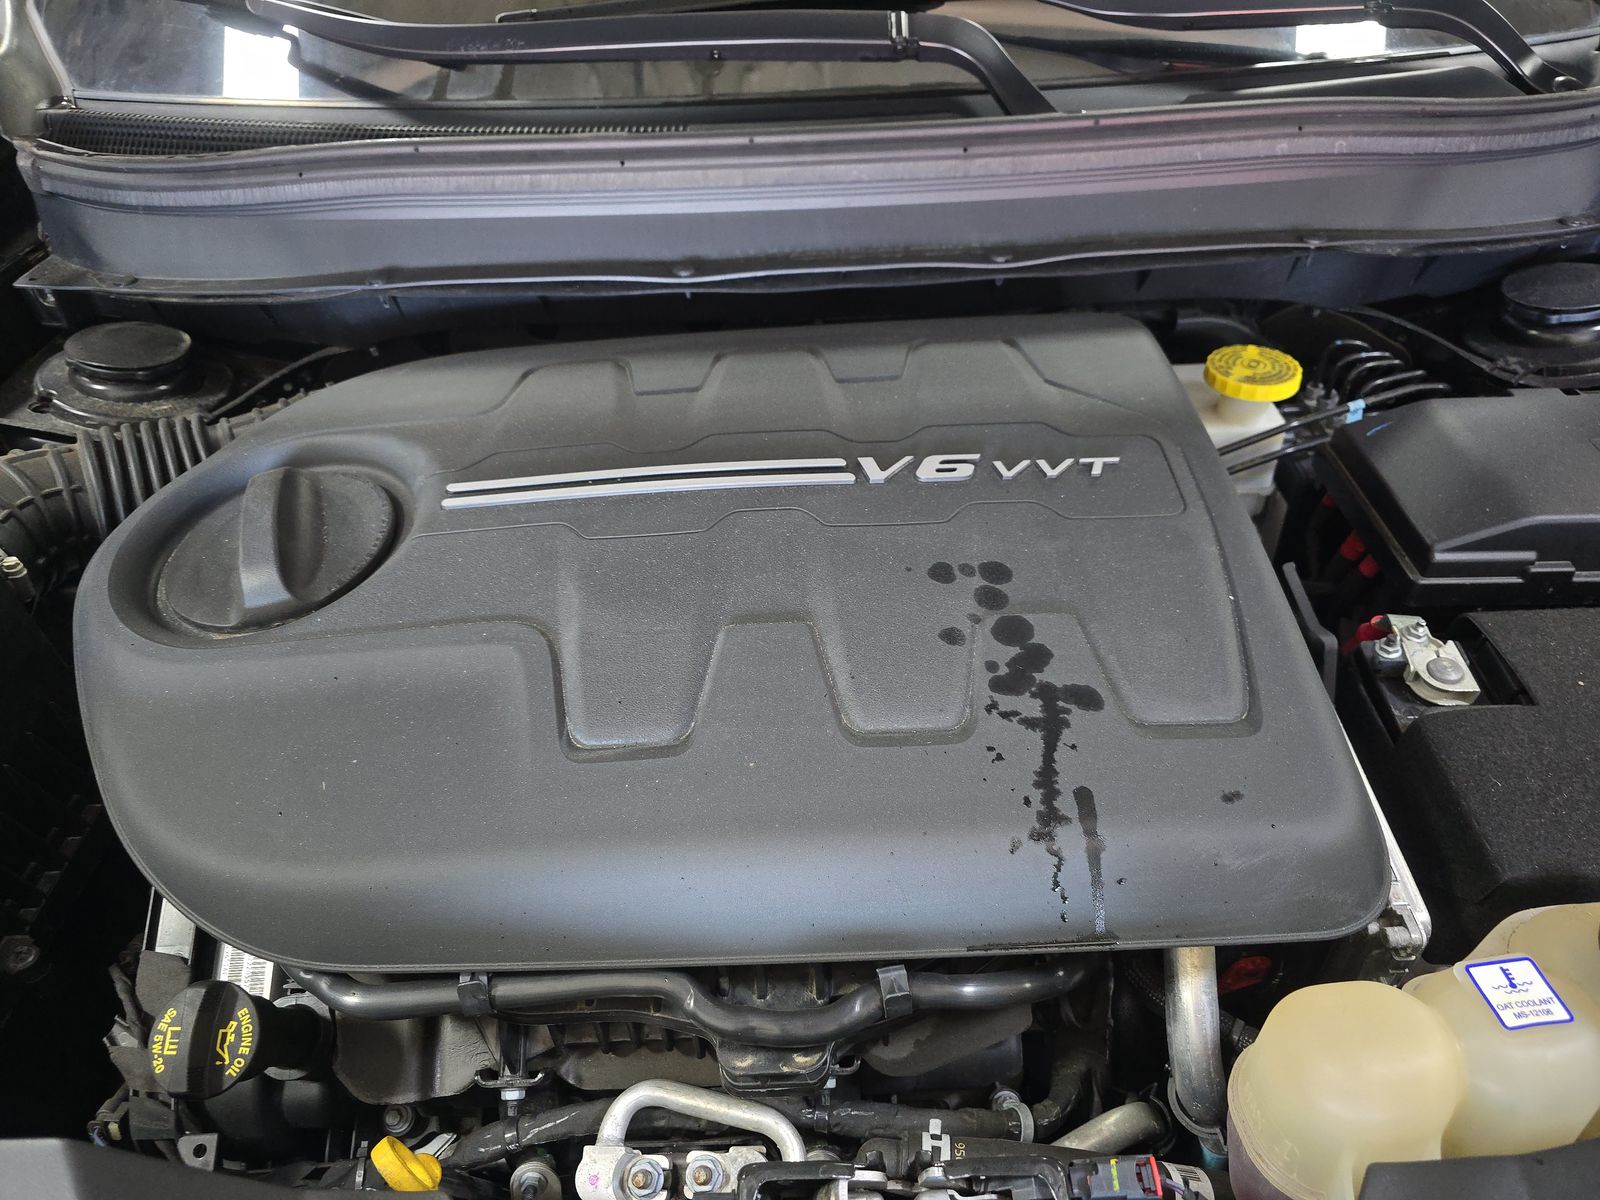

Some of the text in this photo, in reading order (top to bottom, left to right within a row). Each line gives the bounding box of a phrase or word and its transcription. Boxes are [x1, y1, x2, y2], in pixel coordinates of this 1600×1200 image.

[857, 453, 1120, 484] V6 VVT
[1496, 996, 1556, 1011] OAT COOLANT
[151, 1007, 177, 1074] SAE 5W-20
[225, 1007, 253, 1078] ENGINE OIL
